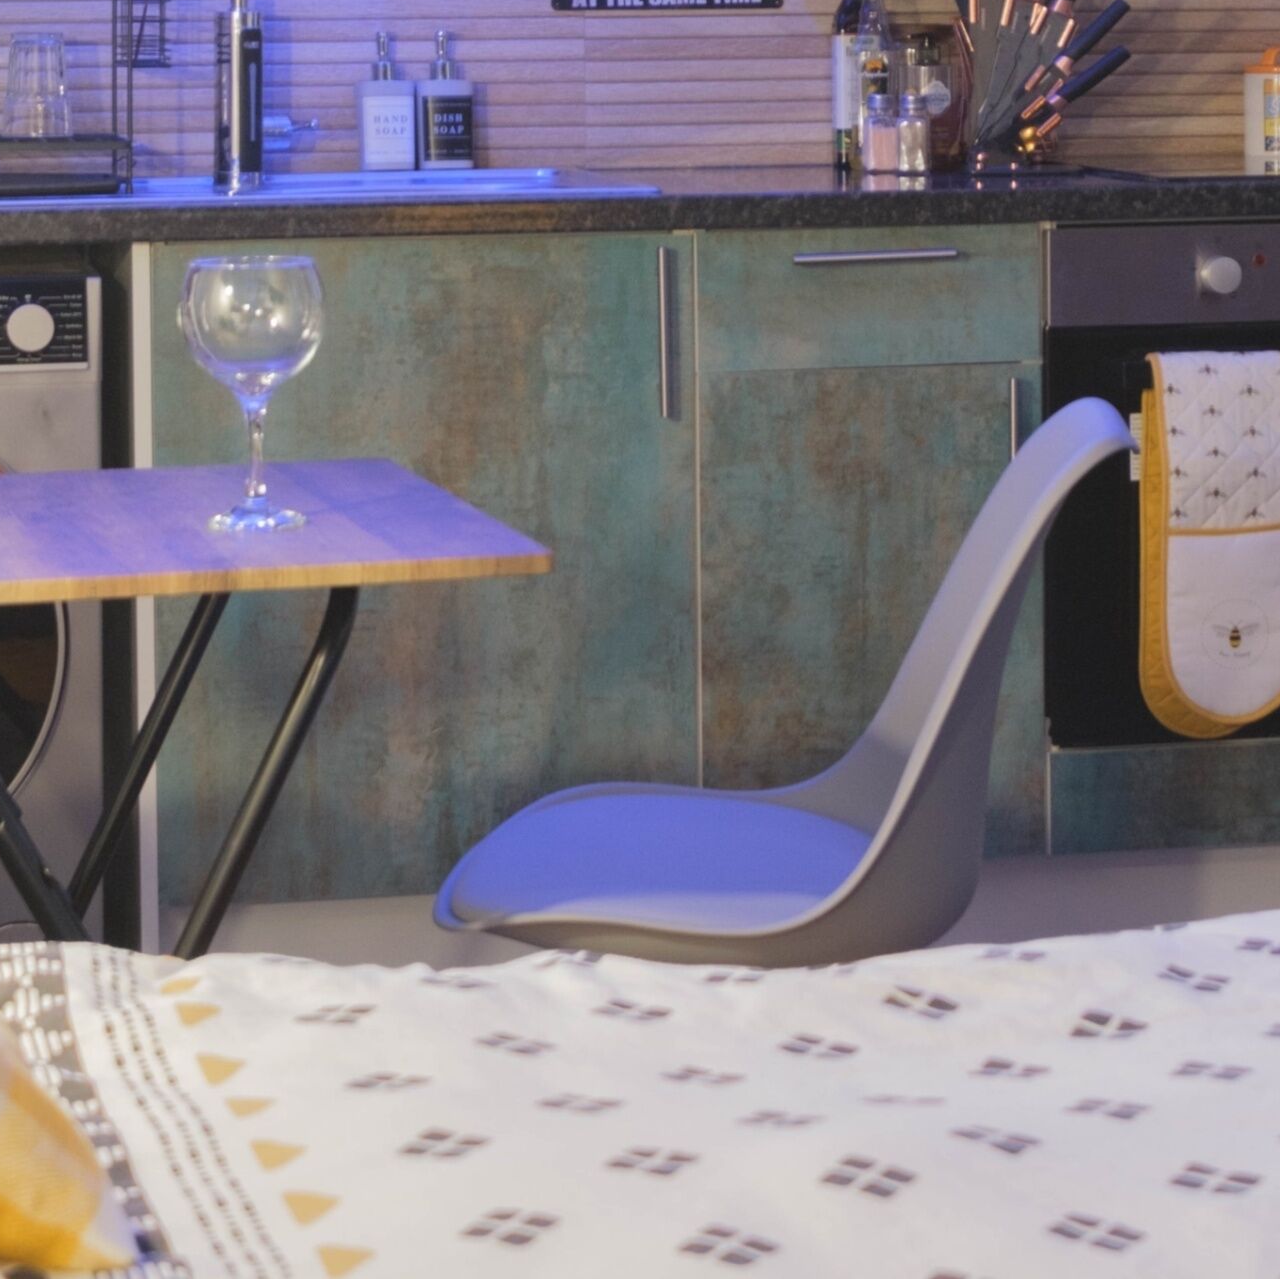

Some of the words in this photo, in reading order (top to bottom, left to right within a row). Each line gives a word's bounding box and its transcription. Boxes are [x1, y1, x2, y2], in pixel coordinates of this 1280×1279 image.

[373, 113, 409, 124] HAND
[433, 112, 463, 123] DISH
[375, 126, 407, 136] SOAP
[433, 124, 465, 135] SOAP
